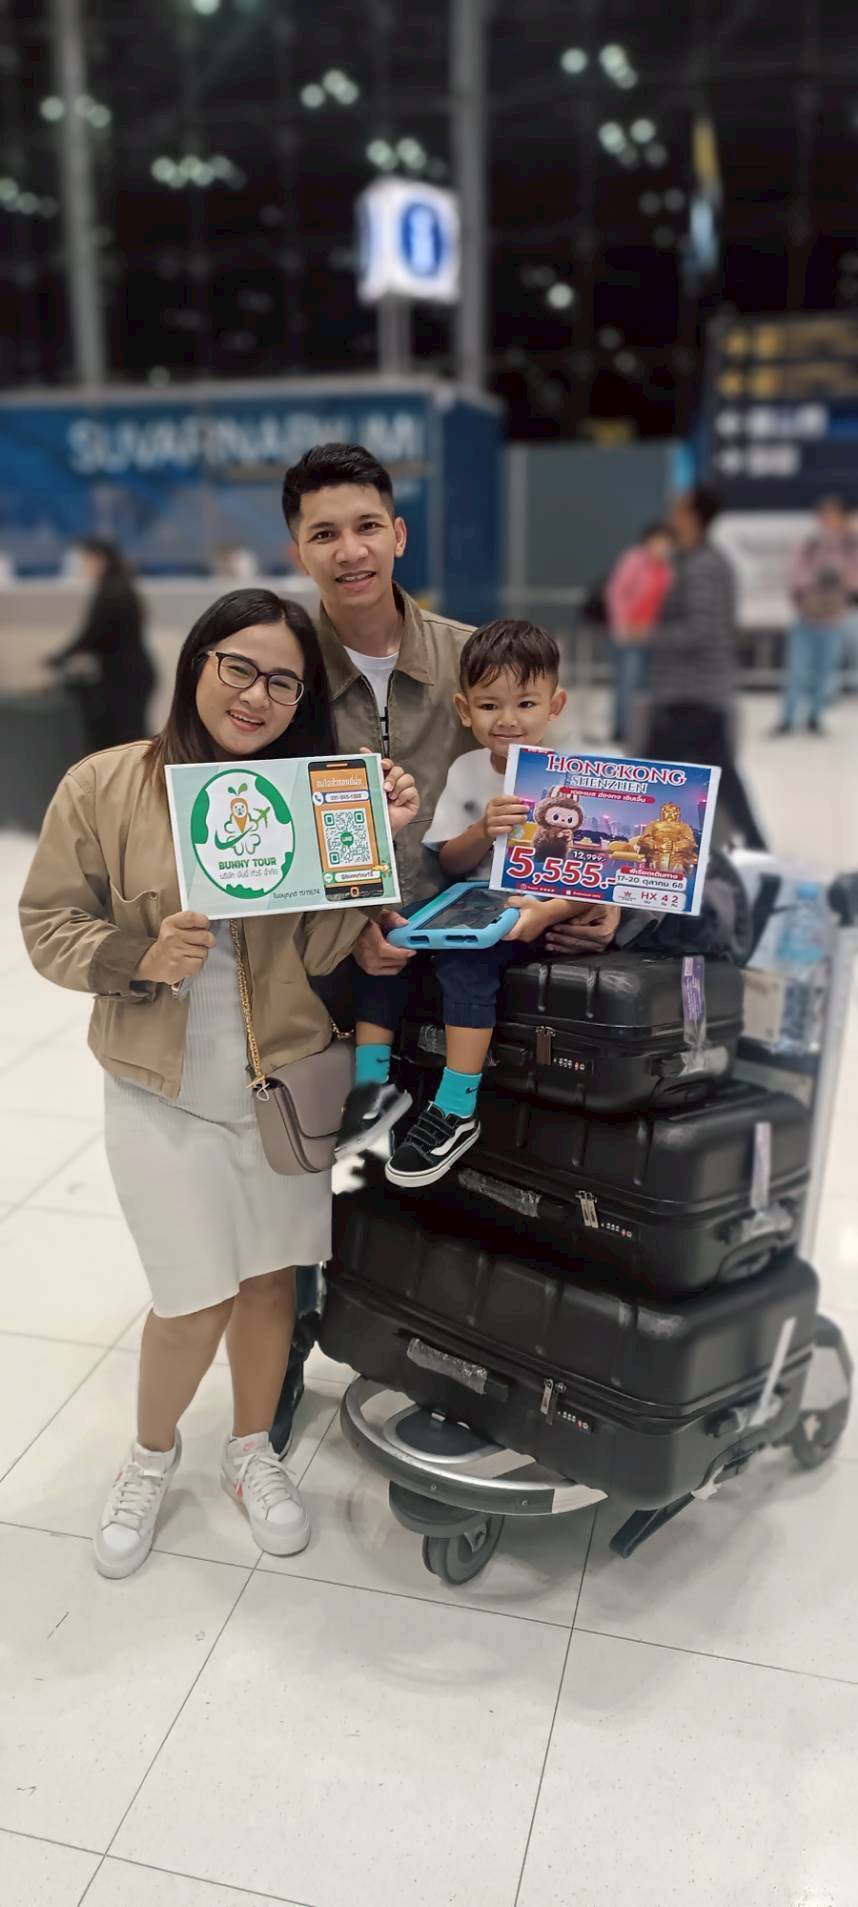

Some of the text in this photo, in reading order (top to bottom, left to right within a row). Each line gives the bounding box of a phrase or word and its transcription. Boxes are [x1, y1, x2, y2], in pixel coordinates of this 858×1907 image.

[546, 754, 687, 786] HONGKONG
[570, 776, 648, 794] SHENZHEN
[218, 857, 277, 870] BUNNY TOUR
[617, 875, 640, 884] 17-20
[642, 879, 669, 888] ตุลาคม
[640, 891, 658, 901] HX
[661, 894, 668, 902] 4
[671, 895, 679, 904] 2
